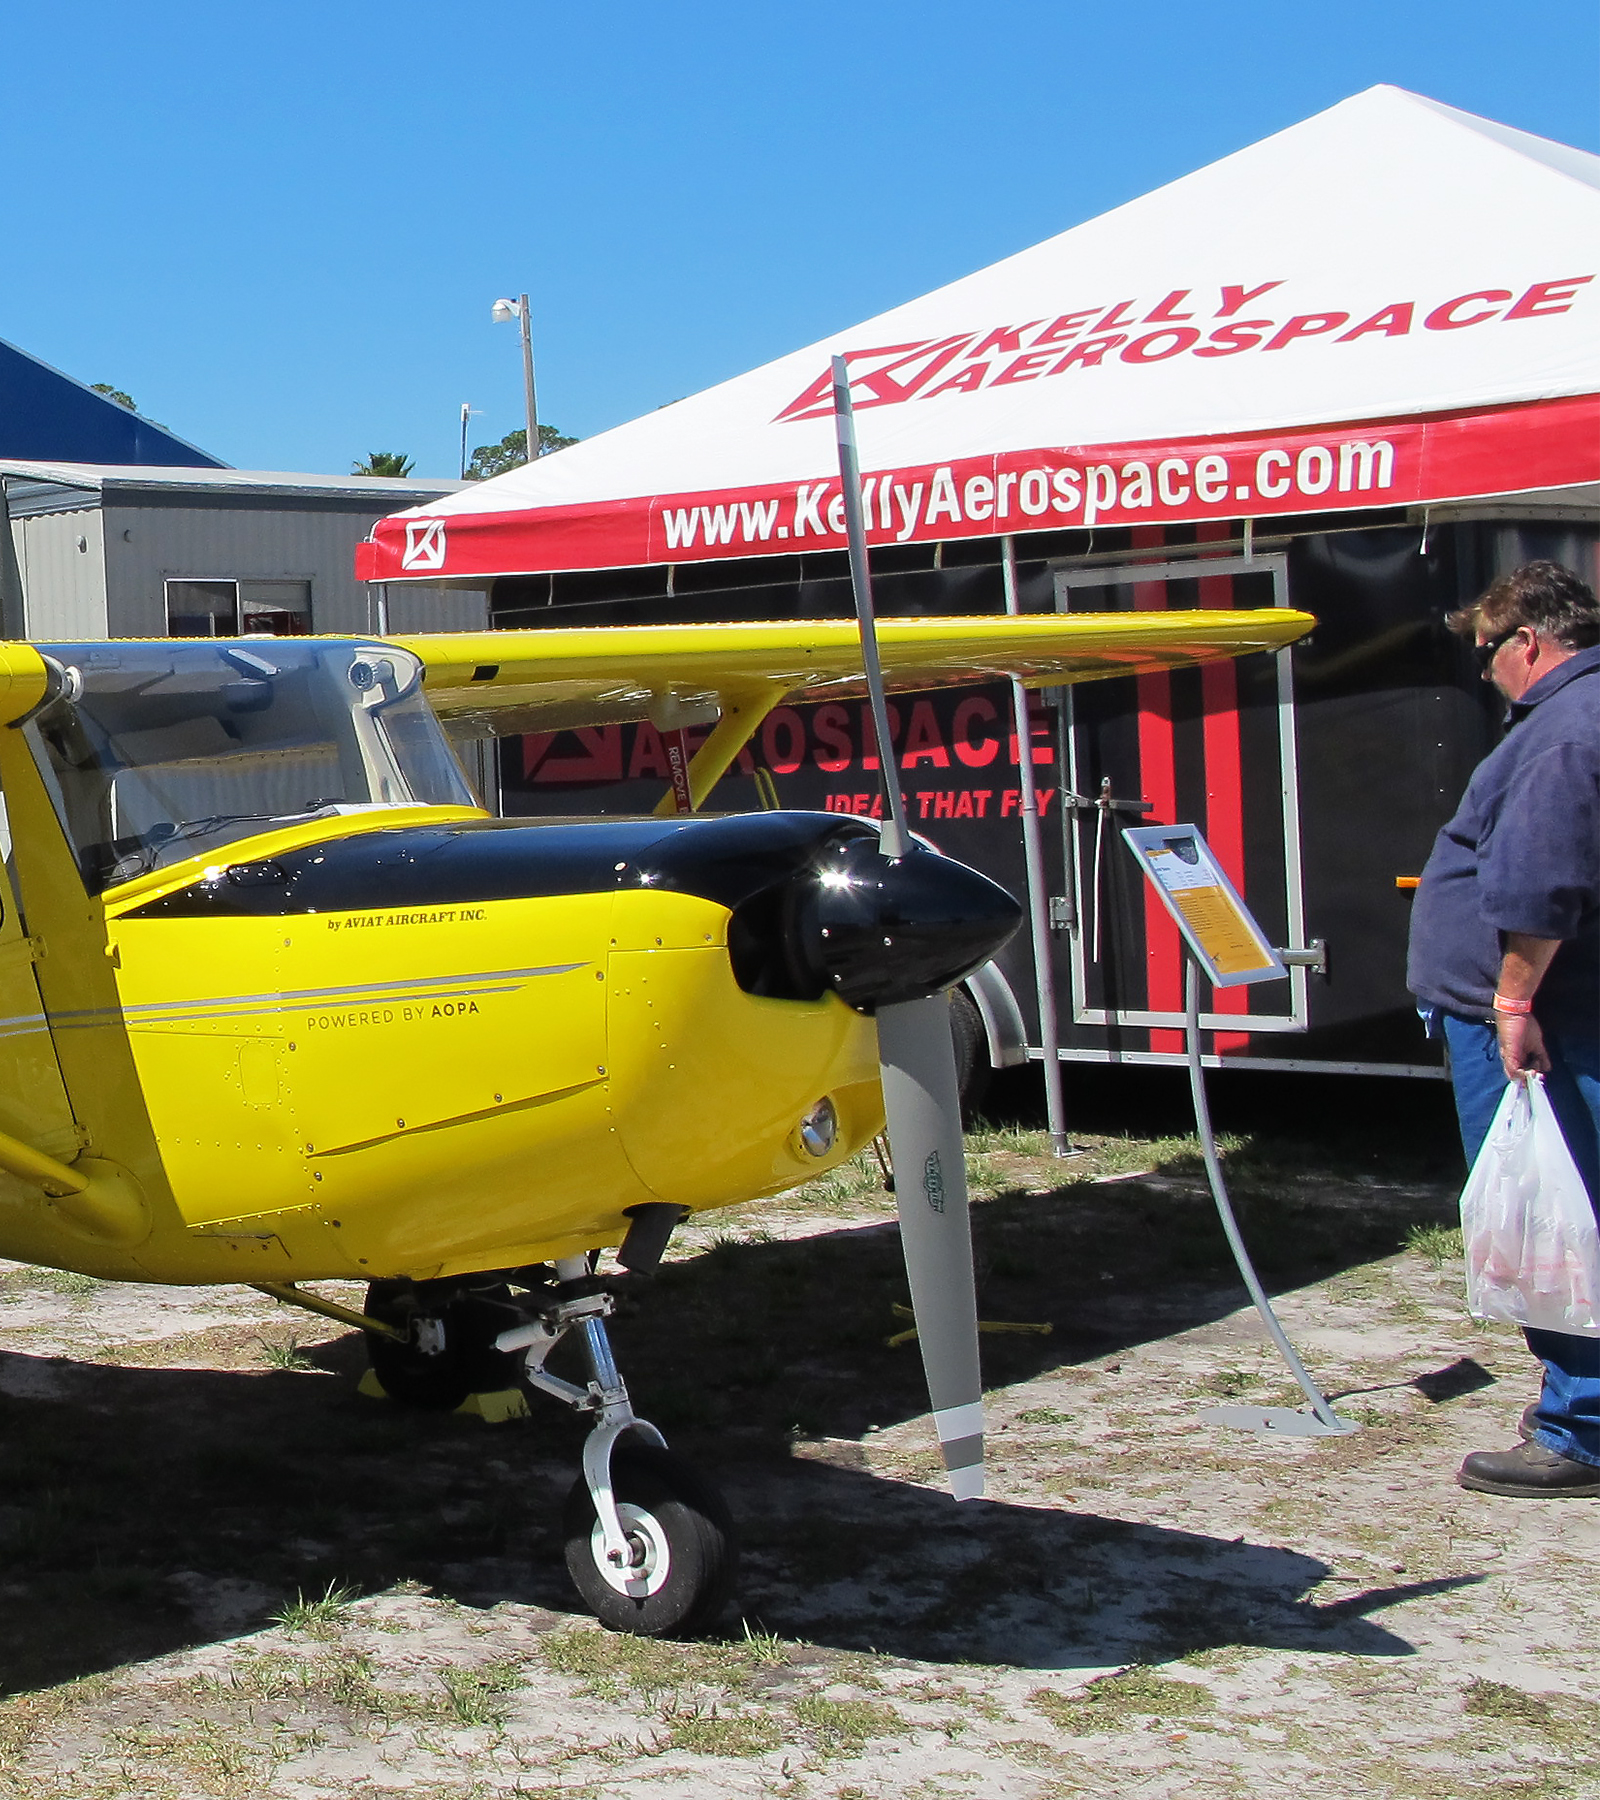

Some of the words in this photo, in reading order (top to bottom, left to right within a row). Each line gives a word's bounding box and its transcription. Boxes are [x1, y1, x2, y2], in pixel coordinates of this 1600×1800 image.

[918, 274, 1598, 400] AEROSPACE
[968, 279, 1288, 357] KELLY
[662, 440, 1395, 549] www.KellyAerospace.com
[629, 695, 1055, 778] AOSPACE
[668, 746, 687, 802] REMOVE
[825, 793, 907, 818] IDEA
[916, 790, 993, 818] THAT
[1001, 789, 1055, 818] FY
[327, 919, 342, 932] by
[344, 916, 384, 930] AVIAT
[386, 911, 456, 927] AIRCRAFT
[459, 908, 488, 922] INC.
[307, 1009, 394, 1031] POWERED
[403, 1006, 425, 1022] BY
[432, 1001, 480, 1019] AOPA
